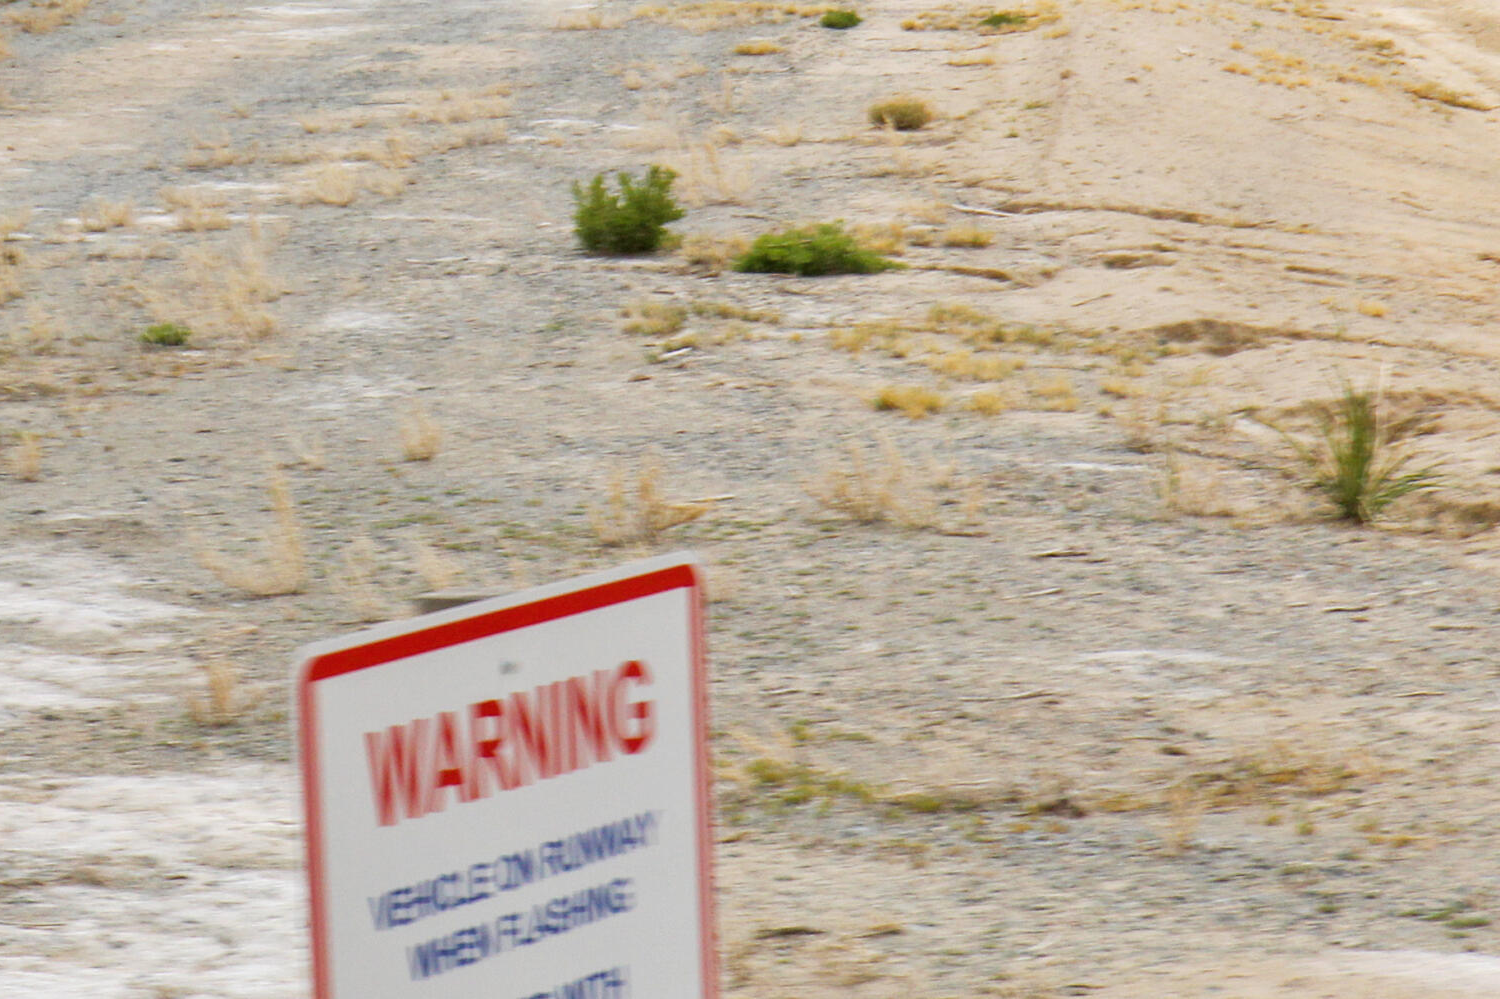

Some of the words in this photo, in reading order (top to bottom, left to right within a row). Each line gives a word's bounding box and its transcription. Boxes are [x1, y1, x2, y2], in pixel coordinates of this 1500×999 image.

[364, 660, 656, 827] WARNING
[368, 861, 494, 930] VEHICLE
[495, 849, 534, 892] ON
[539, 809, 663, 877] RUNWAY
[405, 923, 490, 981] WHEN
[496, 878, 637, 953] FLASHING
